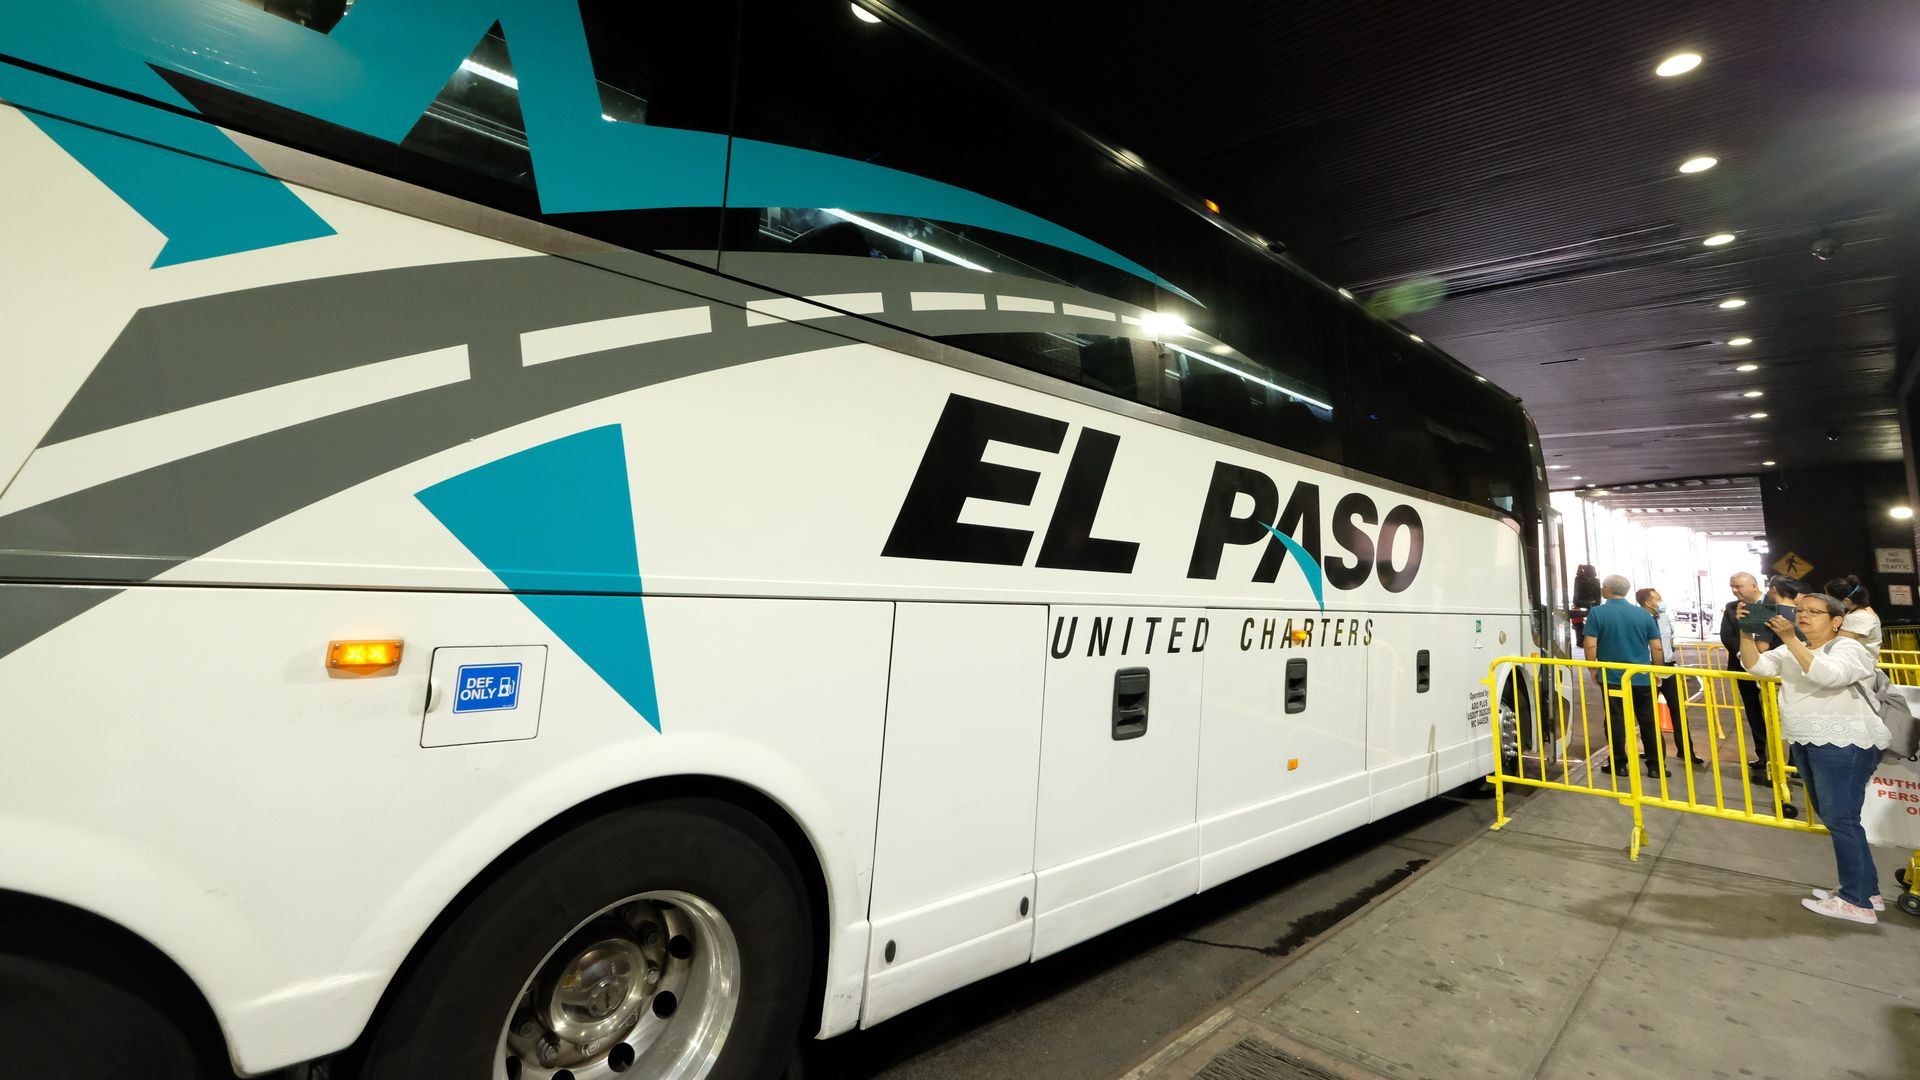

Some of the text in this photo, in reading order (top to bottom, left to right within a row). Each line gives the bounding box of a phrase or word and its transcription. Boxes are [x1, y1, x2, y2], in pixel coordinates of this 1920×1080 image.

[880, 392, 1424, 594] EL PASO
[1050, 616, 1374, 659] UNITED CHARTERS
[466, 676, 495, 689] DEF
[460, 688, 497, 701] ONLY
[1469, 690, 1484, 700] Operated
[1906, 806, 1920, 816] O
